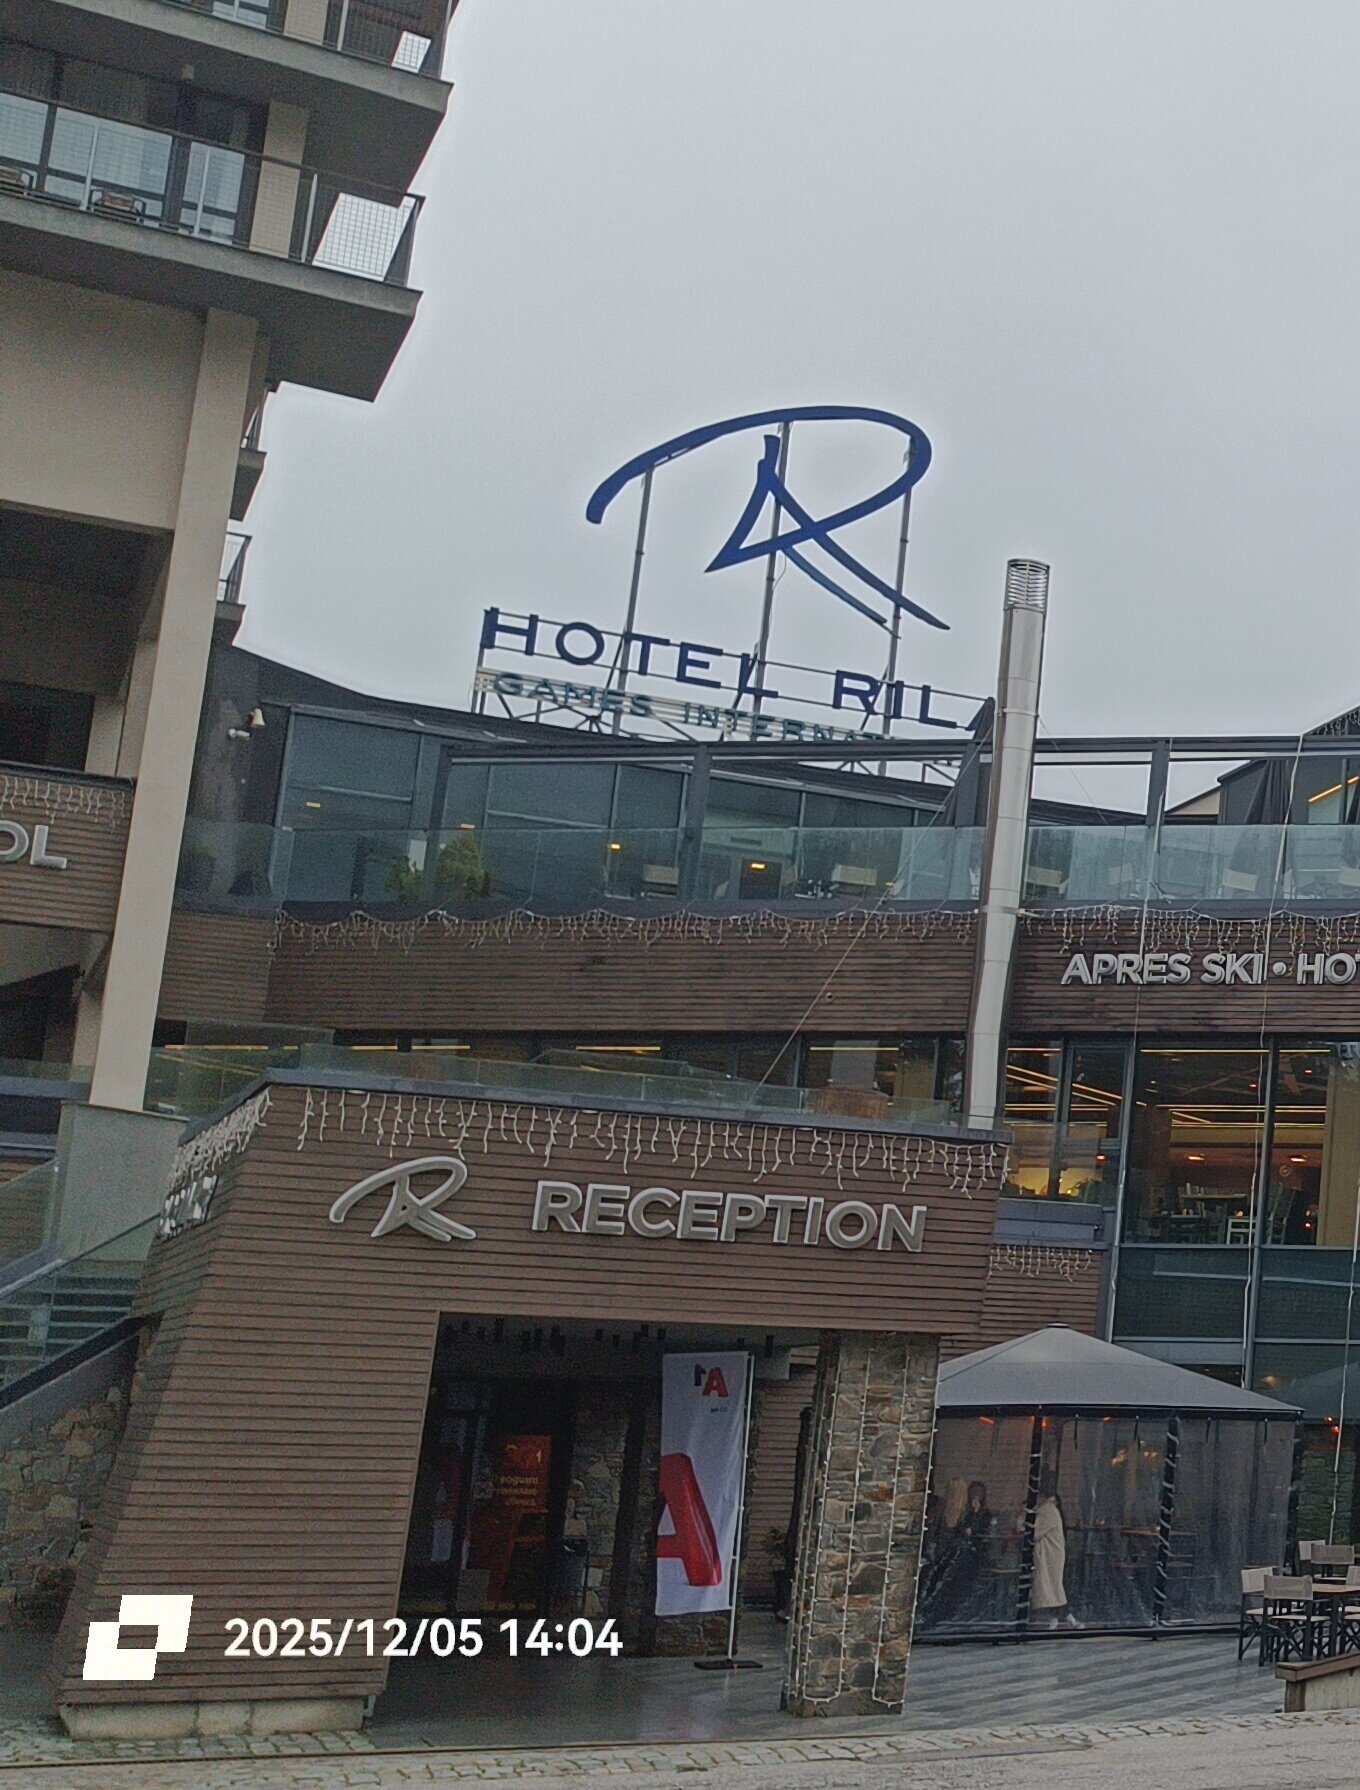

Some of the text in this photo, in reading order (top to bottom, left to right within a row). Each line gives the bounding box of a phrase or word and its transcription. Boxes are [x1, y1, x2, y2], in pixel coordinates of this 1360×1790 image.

[483, 606, 779, 698] HOTEL
[494, 672, 653, 717] GAMES
[1061, 953, 1191, 985] APRES
[1201, 953, 1263, 985] SKI
[532, 1180, 927, 1252] RECEPTION
